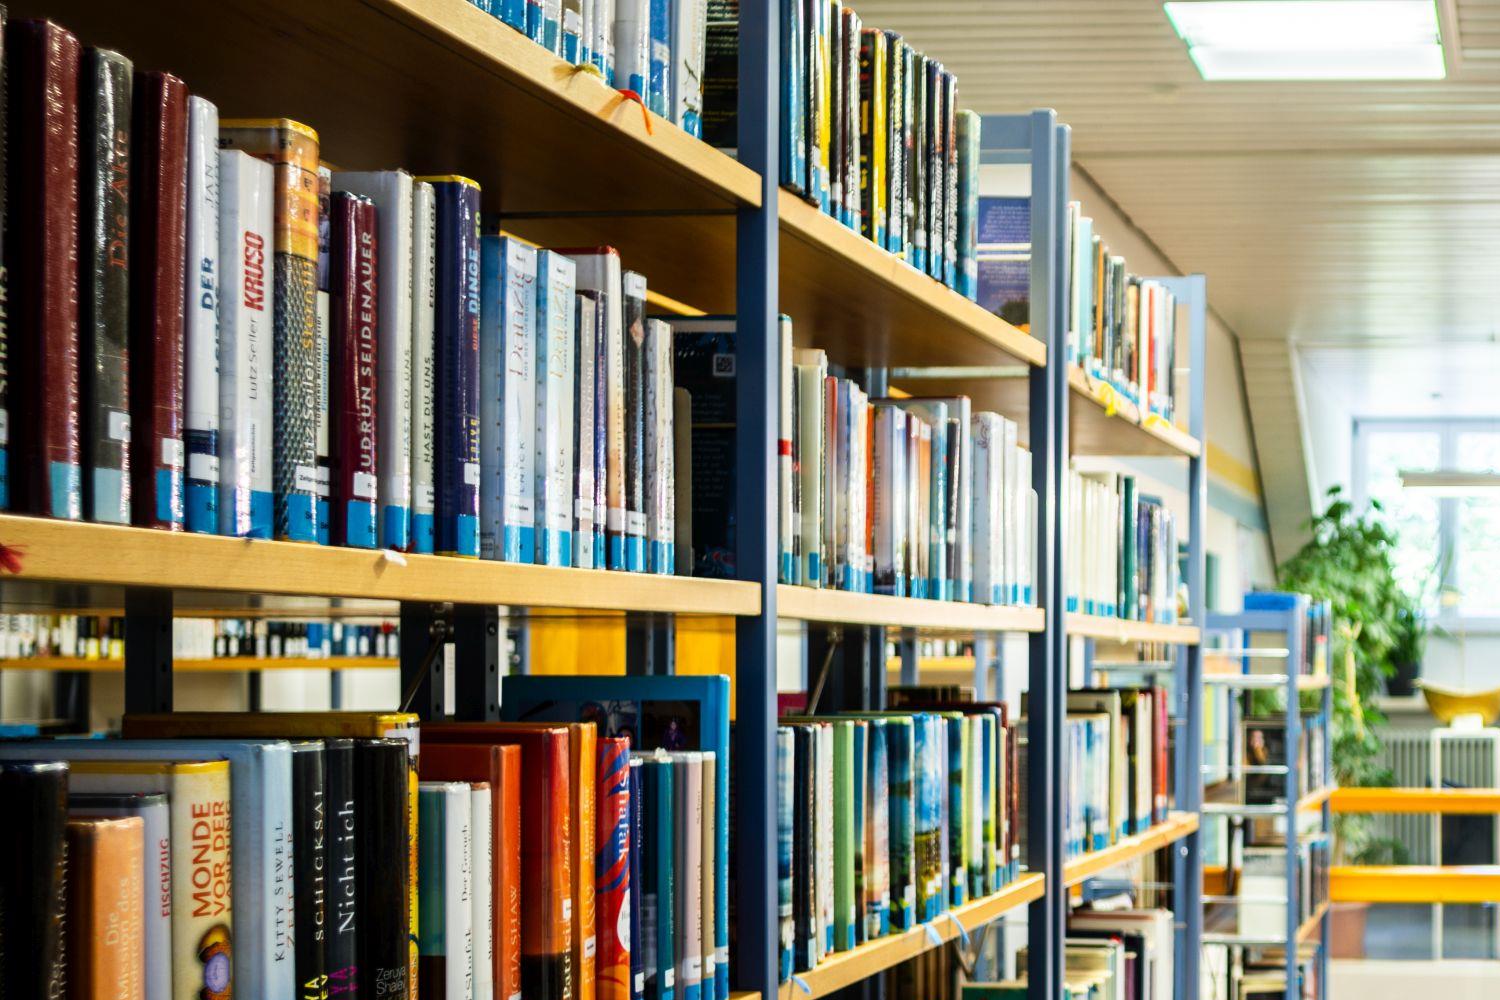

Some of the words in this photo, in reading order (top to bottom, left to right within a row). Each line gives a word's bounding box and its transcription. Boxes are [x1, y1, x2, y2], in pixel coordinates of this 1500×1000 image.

[111, 130, 128, 203] Akte
[109, 214, 128, 270] Die
[244, 230, 265, 312] KRUSO
[201, 257, 214, 311] DER
[361, 232, 372, 376] SEIDENAUER
[468, 247, 478, 314] DINGE
[247, 318, 259, 364] Seiler
[248, 366, 259, 400] Lutz
[303, 359, 315, 420] Seiler
[360, 386, 371, 473] UDRUN
[213, 800, 225, 853] DER
[337, 799, 354, 845] ich
[160, 839, 170, 918] FISCHZUG
[192, 803, 212, 917] MONDE
[213, 860, 226, 916] VOR
[273, 821, 284, 896] SEWELL
[314, 782, 324, 941] SCHICKSAL
[117, 877, 130, 912] des
[337, 854, 355, 935] Nicht
[510, 885, 519, 946] SHAW
[105, 912, 119, 946] Die
[117, 914, 131, 1000] Mission
[274, 906, 285, 962] KITTY
